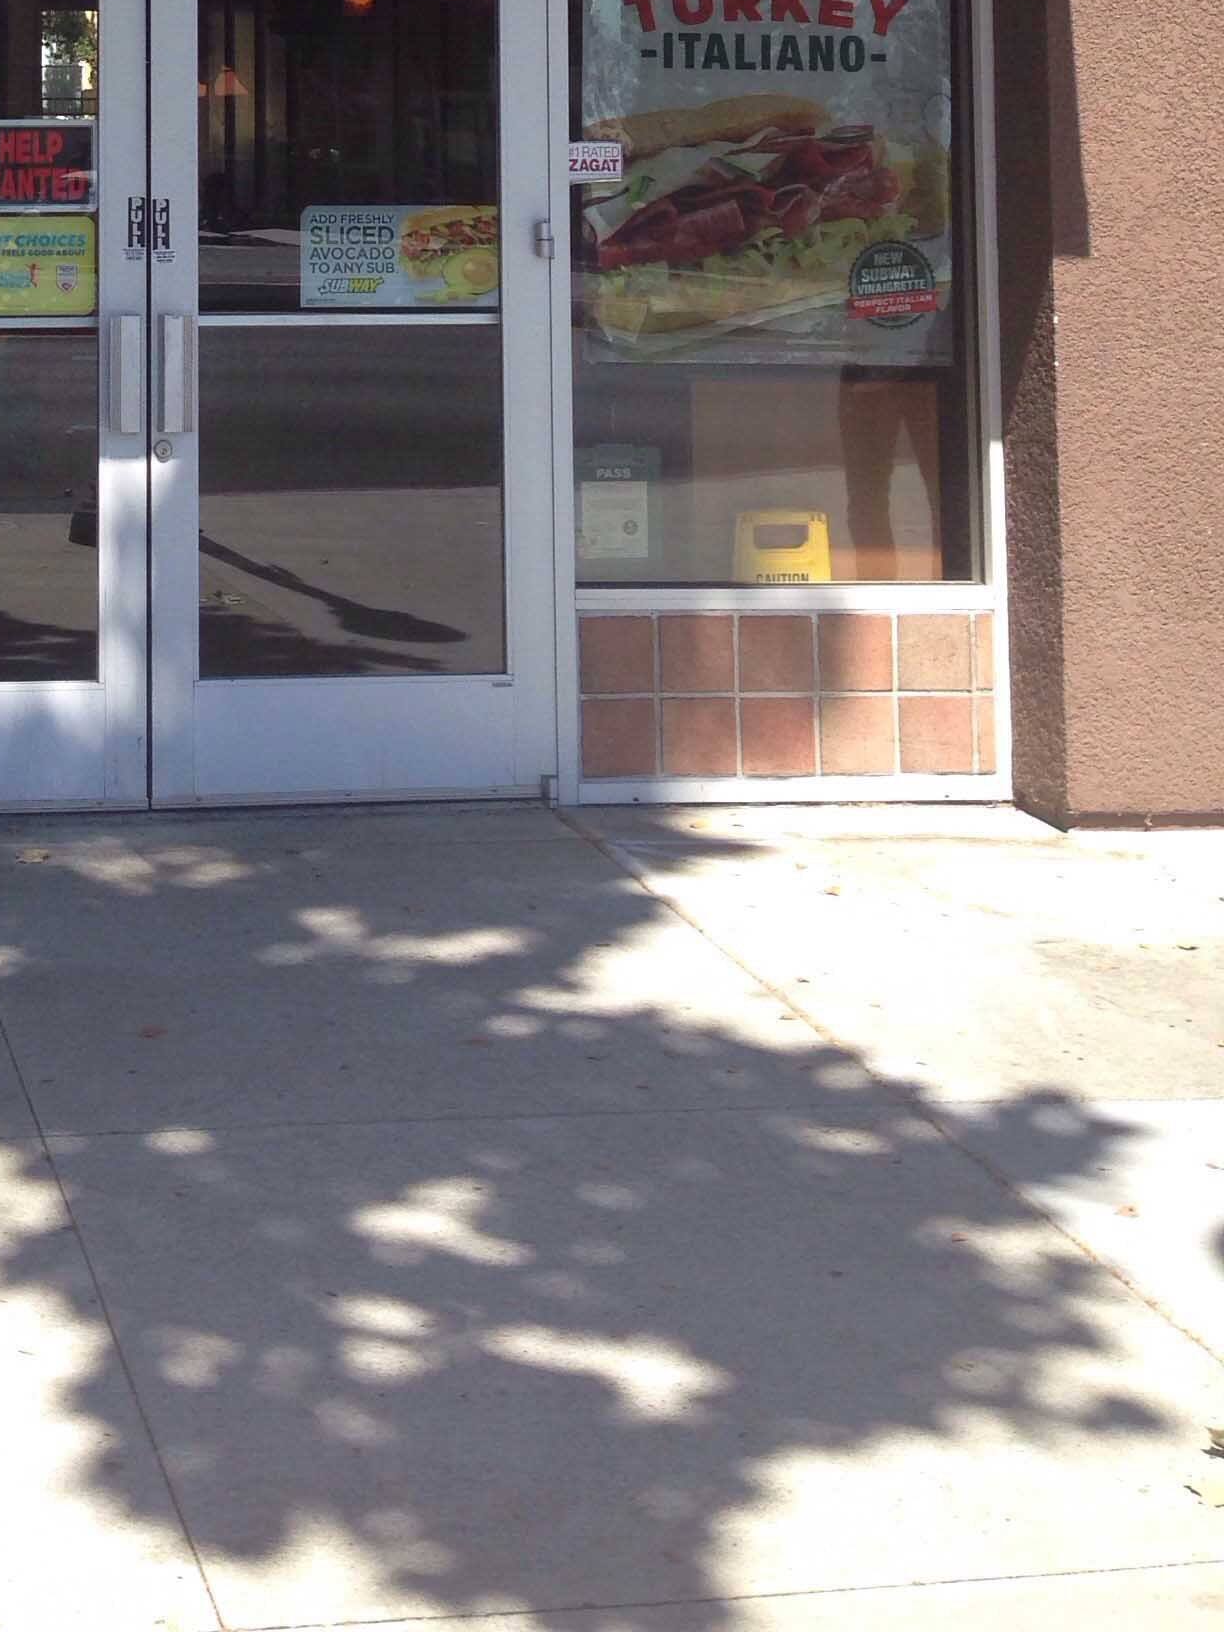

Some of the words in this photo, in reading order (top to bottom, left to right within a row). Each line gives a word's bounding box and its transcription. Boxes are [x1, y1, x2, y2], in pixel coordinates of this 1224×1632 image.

[582, 146, 619, 158] RATED
[569, 158, 619, 172] ZAGAT
[130, 197, 143, 248] PULL
[154, 199, 167, 250] PULL
[310, 214, 337, 224] ADD
[340, 213, 394, 224] FRESHLY
[15, 233, 86, 248] CHOICES
[310, 225, 395, 245] SLICED
[310, 247, 395, 260] AVOCADO
[872, 250, 904, 265] NEW
[309, 262, 330, 274] TO
[332, 262, 365, 274] ANY
[317, 276, 384, 295] SUBWAY
[857, 279, 927, 295] VINAIGRETTE
[596, 468, 632, 479] PASS
[755, 572, 809, 583] CAUTION
